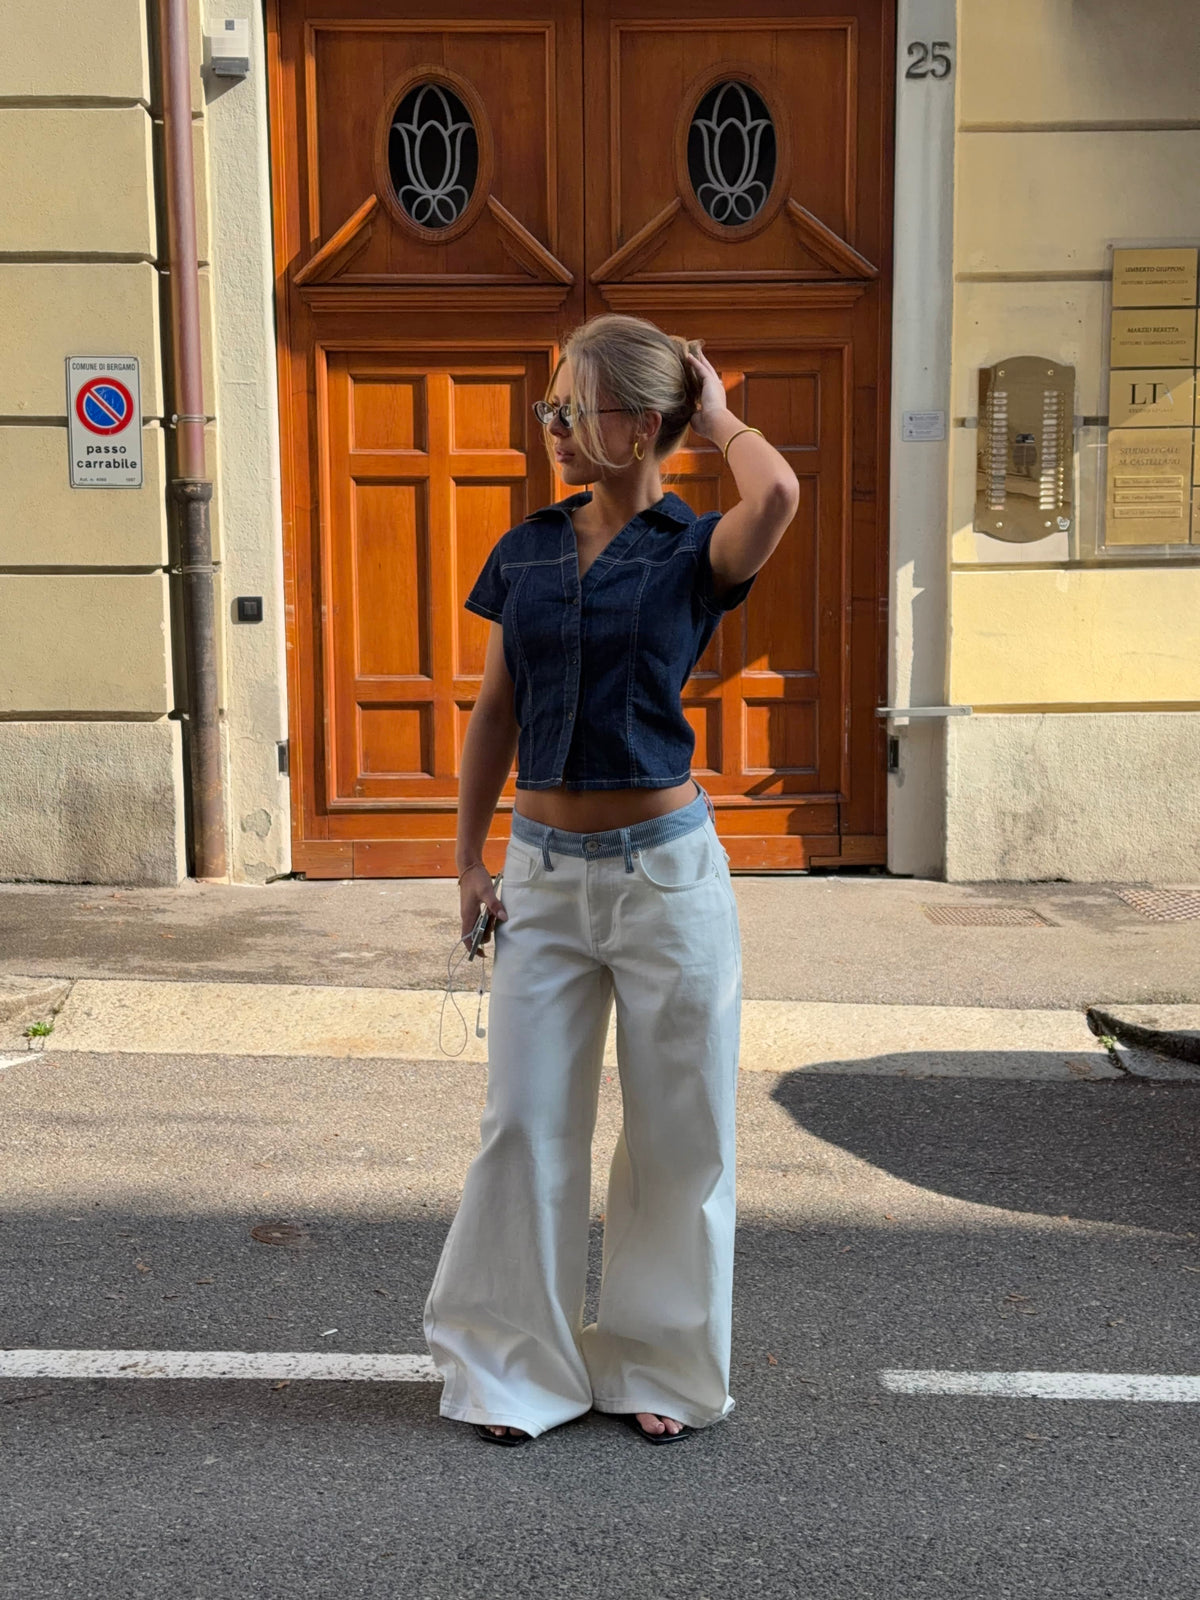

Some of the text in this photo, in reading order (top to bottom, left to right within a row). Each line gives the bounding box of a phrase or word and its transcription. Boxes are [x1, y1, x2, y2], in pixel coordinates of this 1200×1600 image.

[905, 41, 951, 79] 25
[72, 363, 135, 371] COMUNE DI BERGAMO
[86, 446, 127, 456] passo
[76, 458, 137, 469] carrabile
